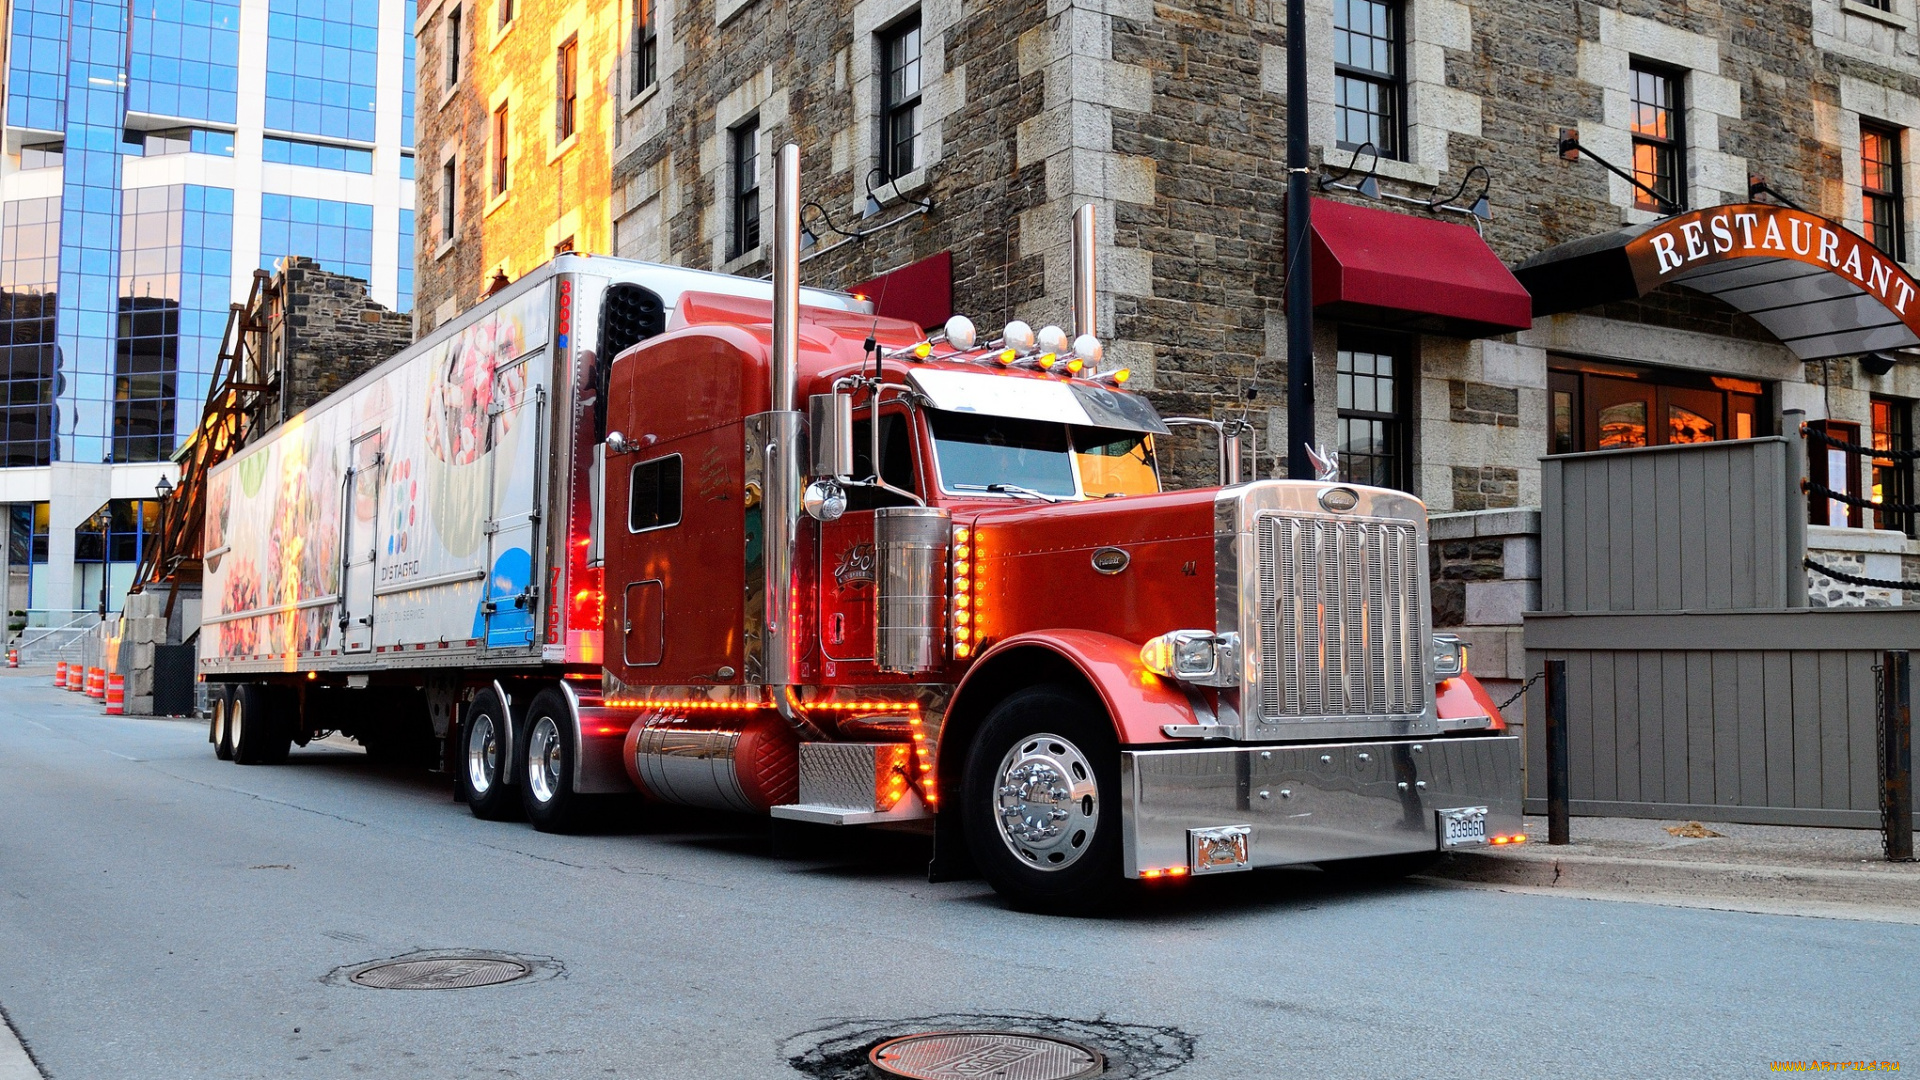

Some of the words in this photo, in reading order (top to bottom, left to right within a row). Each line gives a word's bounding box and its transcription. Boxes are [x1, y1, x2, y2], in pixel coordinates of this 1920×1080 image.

[1650, 213, 1915, 316] RESTAURANT
[559, 280, 571, 348] 3000R
[382, 560, 419, 581] DISTAGRO
[1181, 560, 1197, 576] 41
